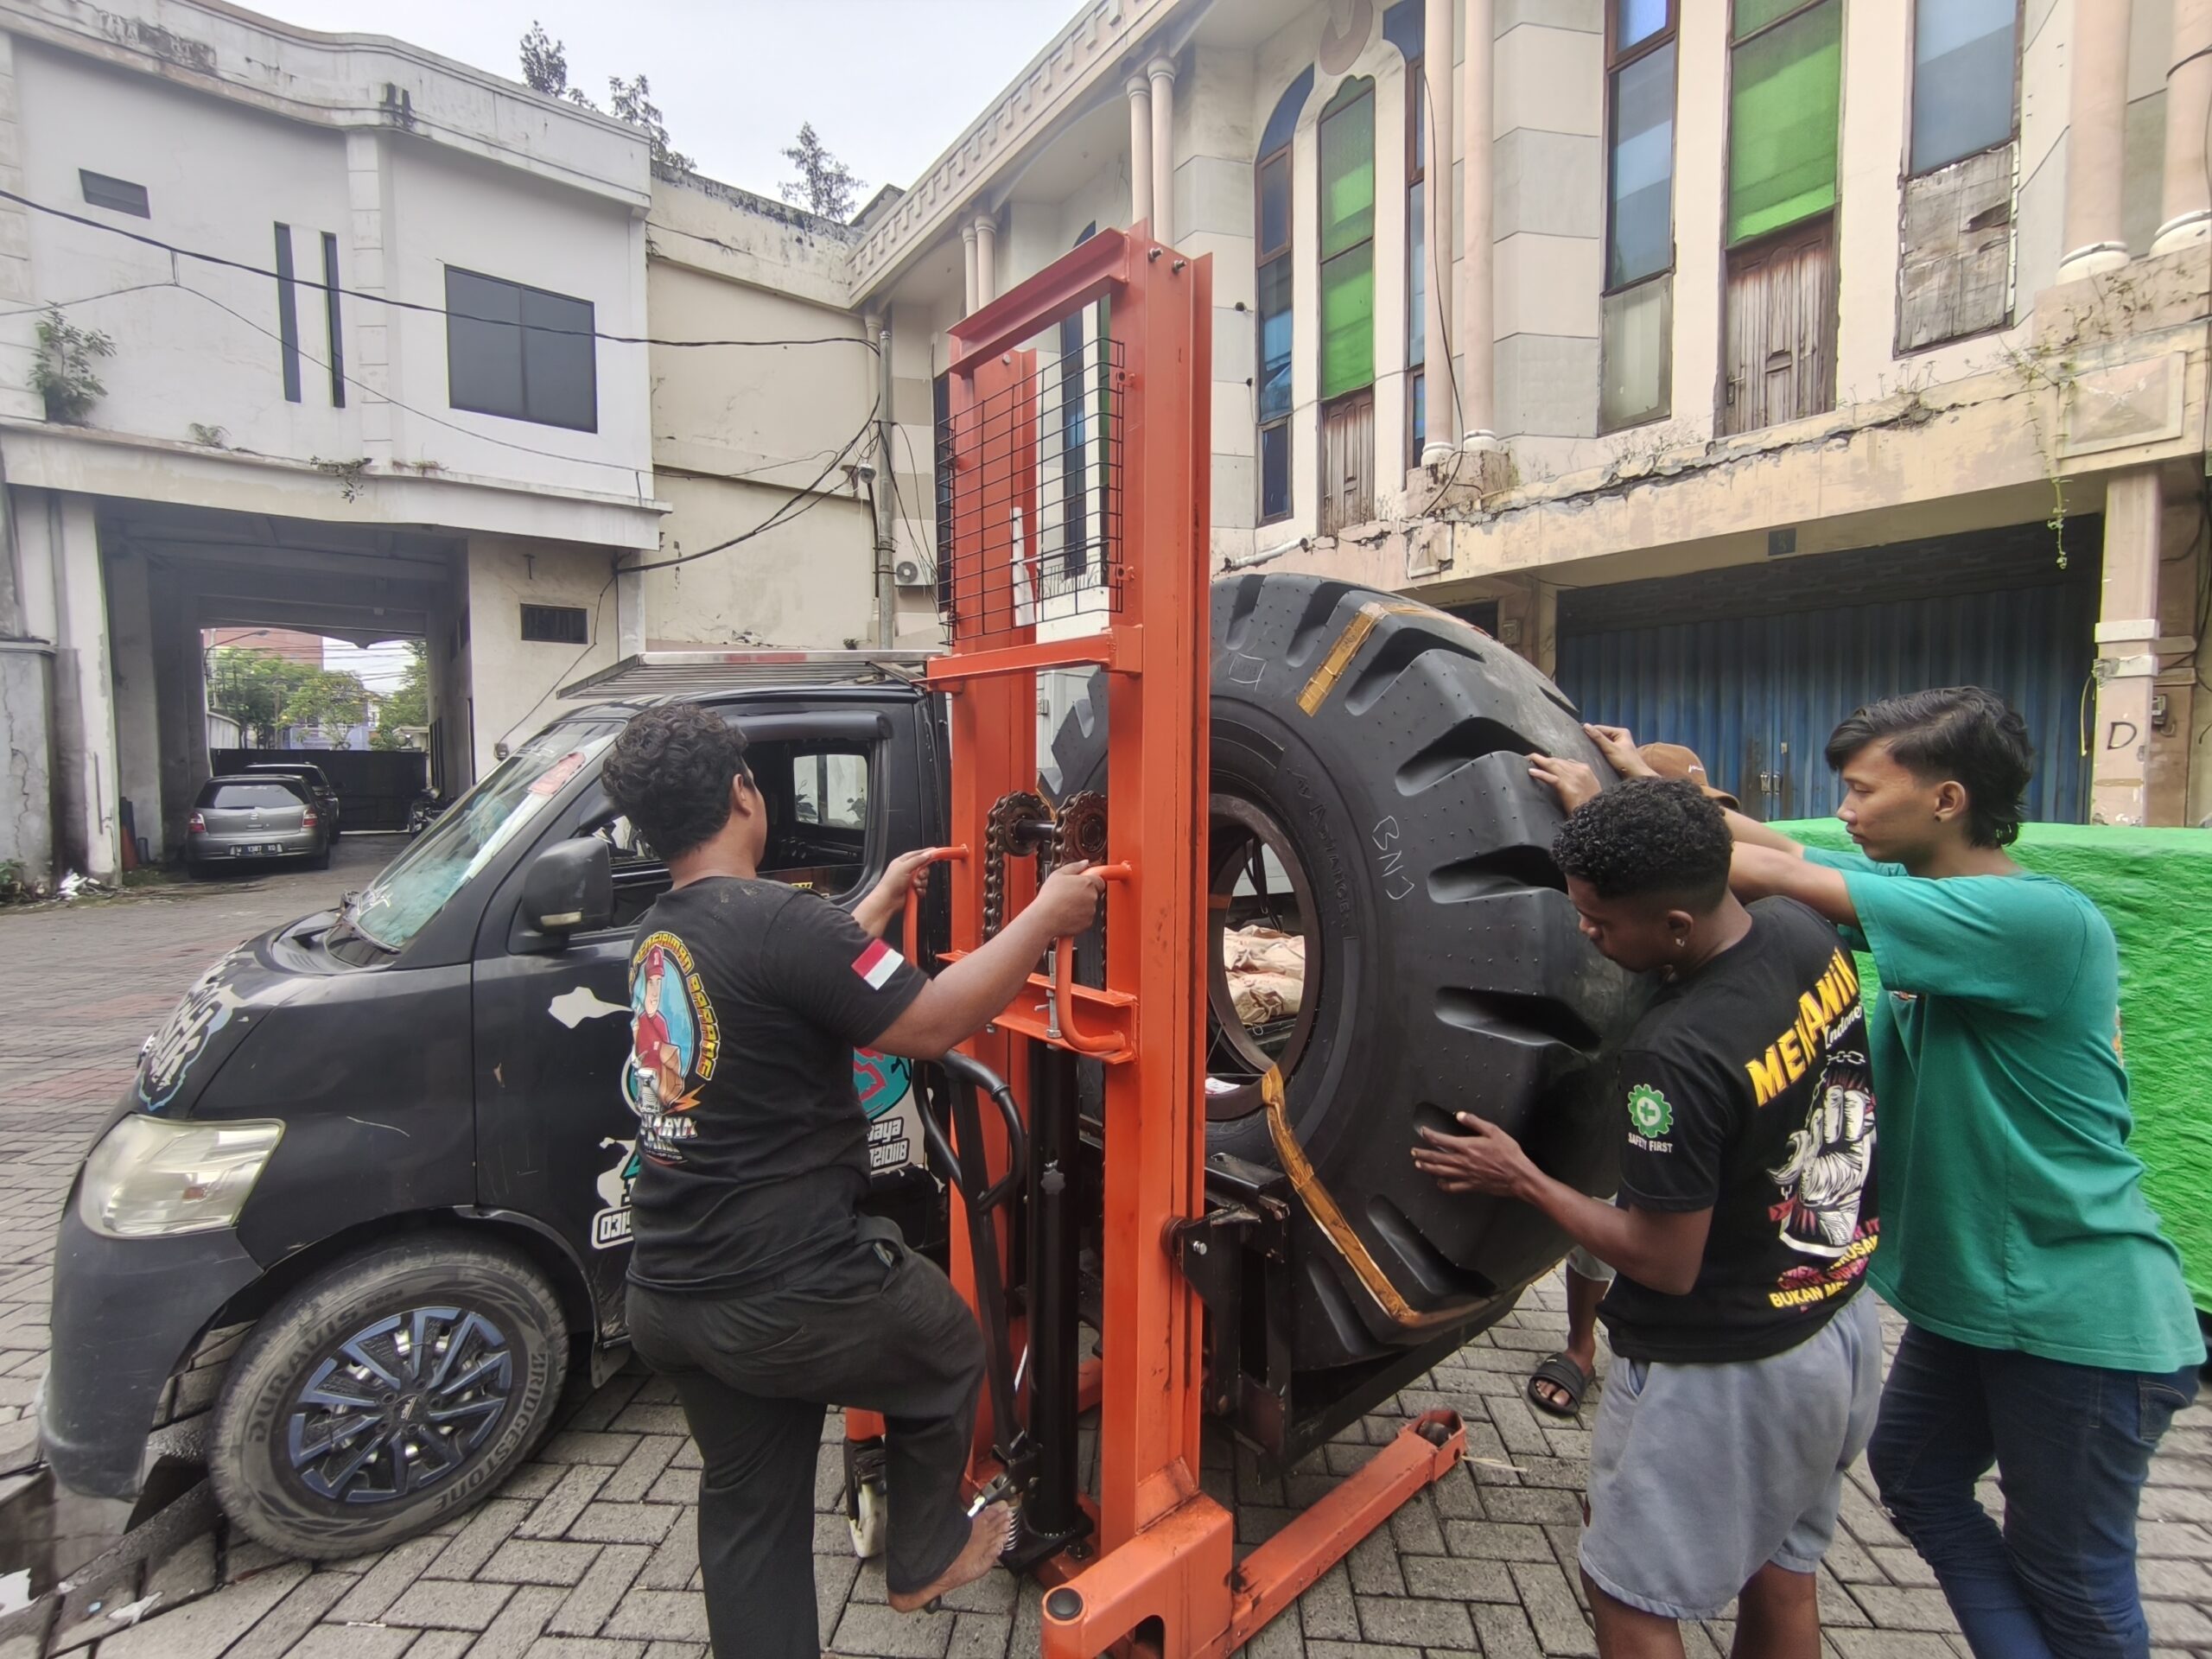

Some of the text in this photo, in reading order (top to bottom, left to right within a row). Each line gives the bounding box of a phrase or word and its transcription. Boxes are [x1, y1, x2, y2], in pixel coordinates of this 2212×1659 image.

[2107, 721, 2138, 750] D
[1649, 1140, 1673, 1153] FIRST
[1769, 1286, 1824, 1308] BUKAN
[251, 1305, 359, 1442] DURAVIS
[433, 1353, 549, 1510] BRIDGESTONE
